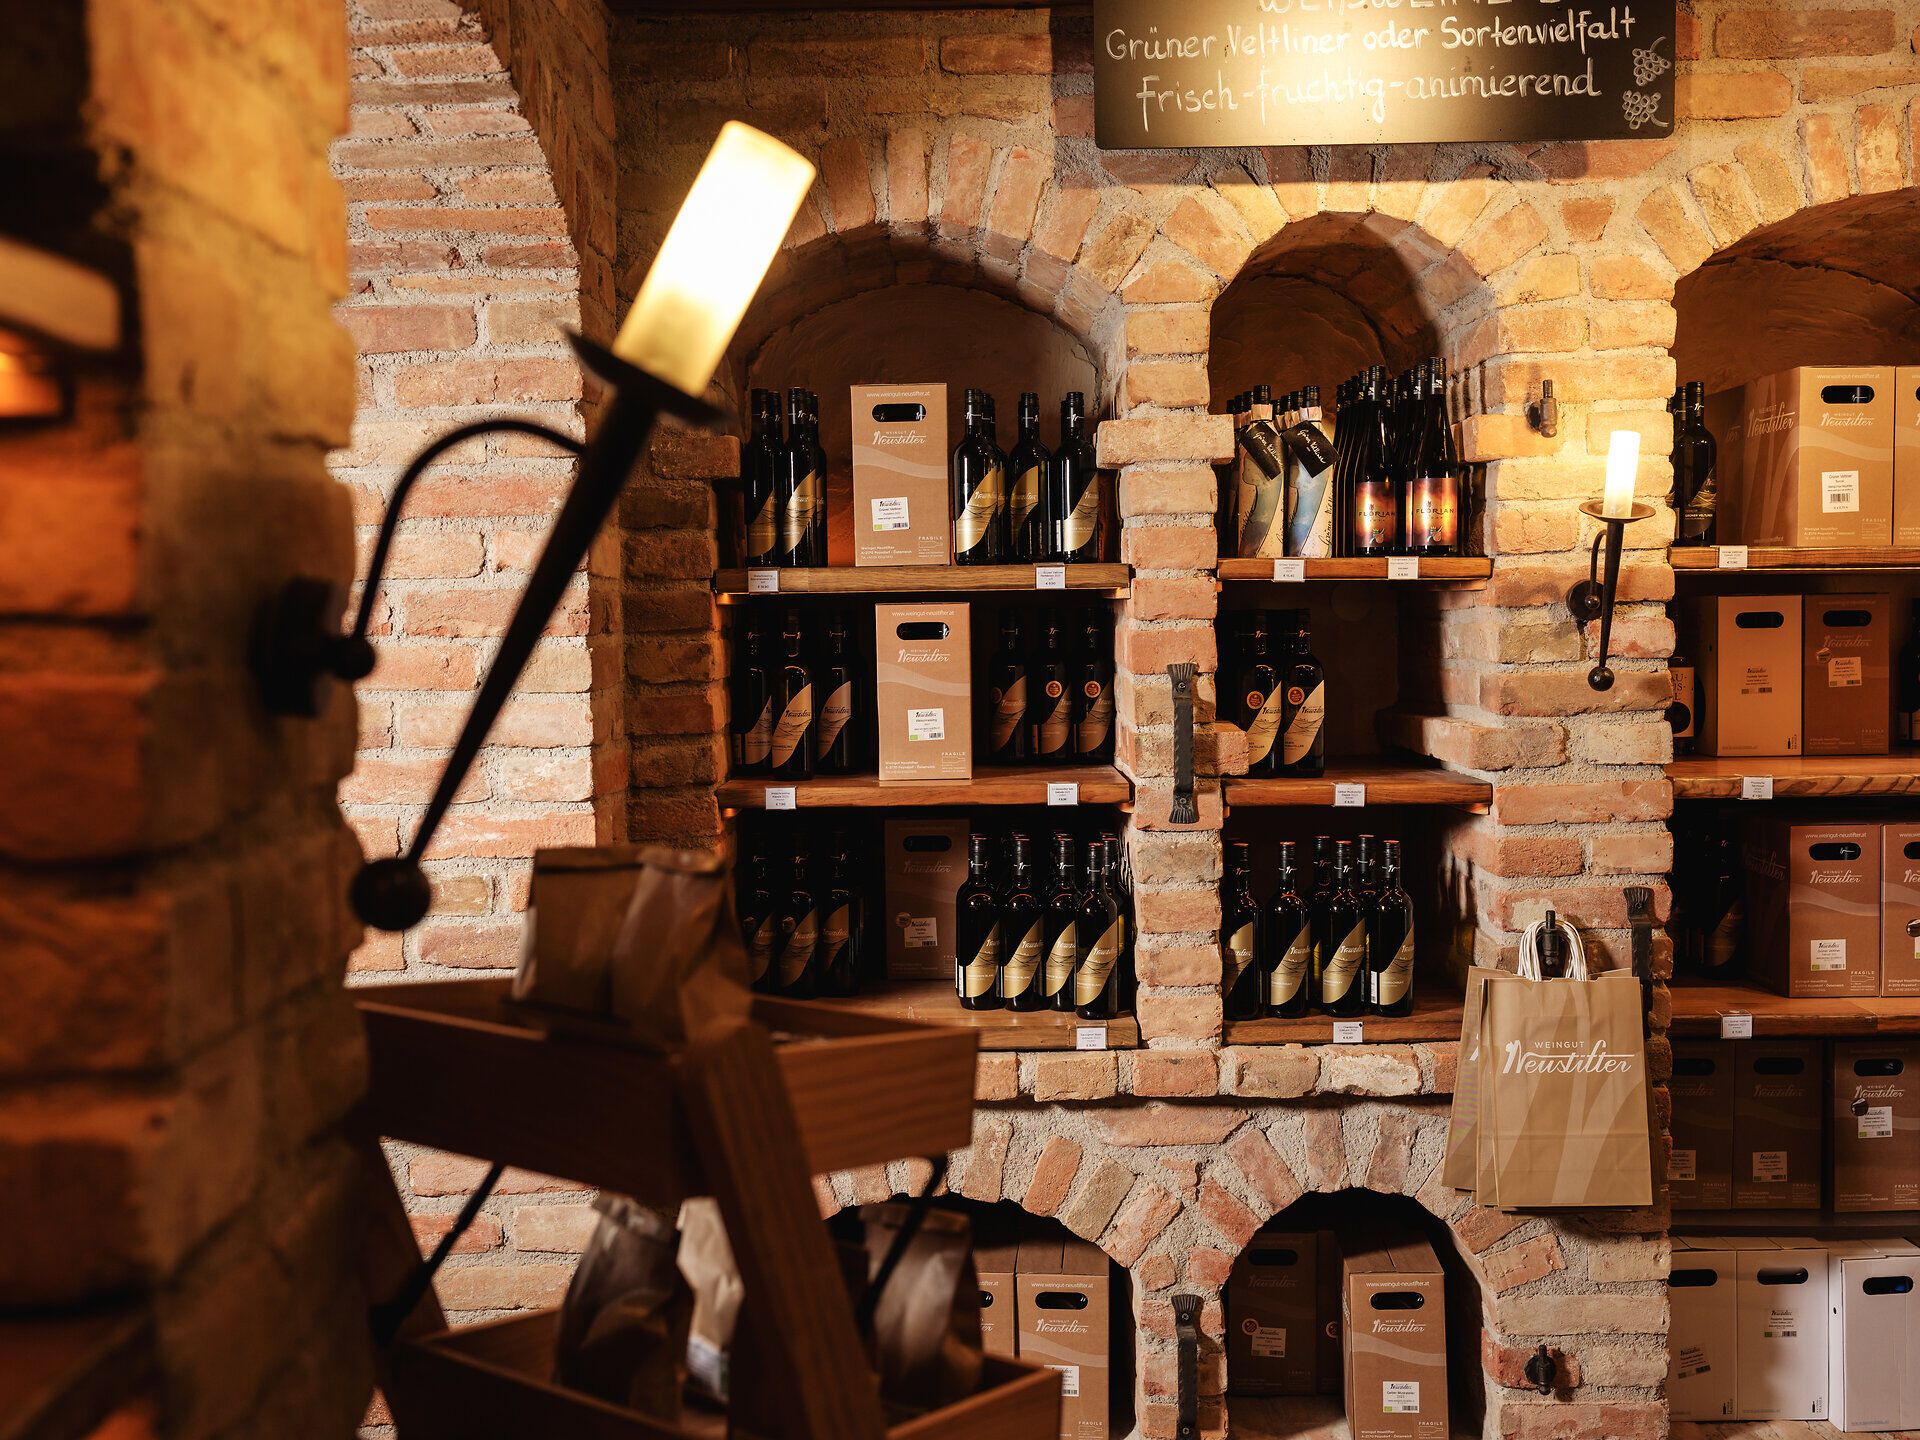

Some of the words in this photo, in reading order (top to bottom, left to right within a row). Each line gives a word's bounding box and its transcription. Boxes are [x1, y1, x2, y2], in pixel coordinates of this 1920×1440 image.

[1105, 25, 1217, 60] Grüner
[1226, 21, 1350, 58] Veltliner
[1362, 19, 1430, 49] oder
[1440, 5, 1637, 54] Sortenvielfalt
[1820, 410, 1875, 426] Neustifter
[872, 430, 927, 445] Neustifter
[897, 648, 951, 663] Neustifter
[1809, 869, 1863, 884] Neustifter
[1534, 1041, 1585, 1049] WEINGUT
[1502, 1039, 1635, 1074] Neustifter
[1854, 1084, 1905, 1099] Neustifter
[1036, 1318, 1089, 1333] Neustifter
[1372, 1318, 1427, 1333] Neustifter
